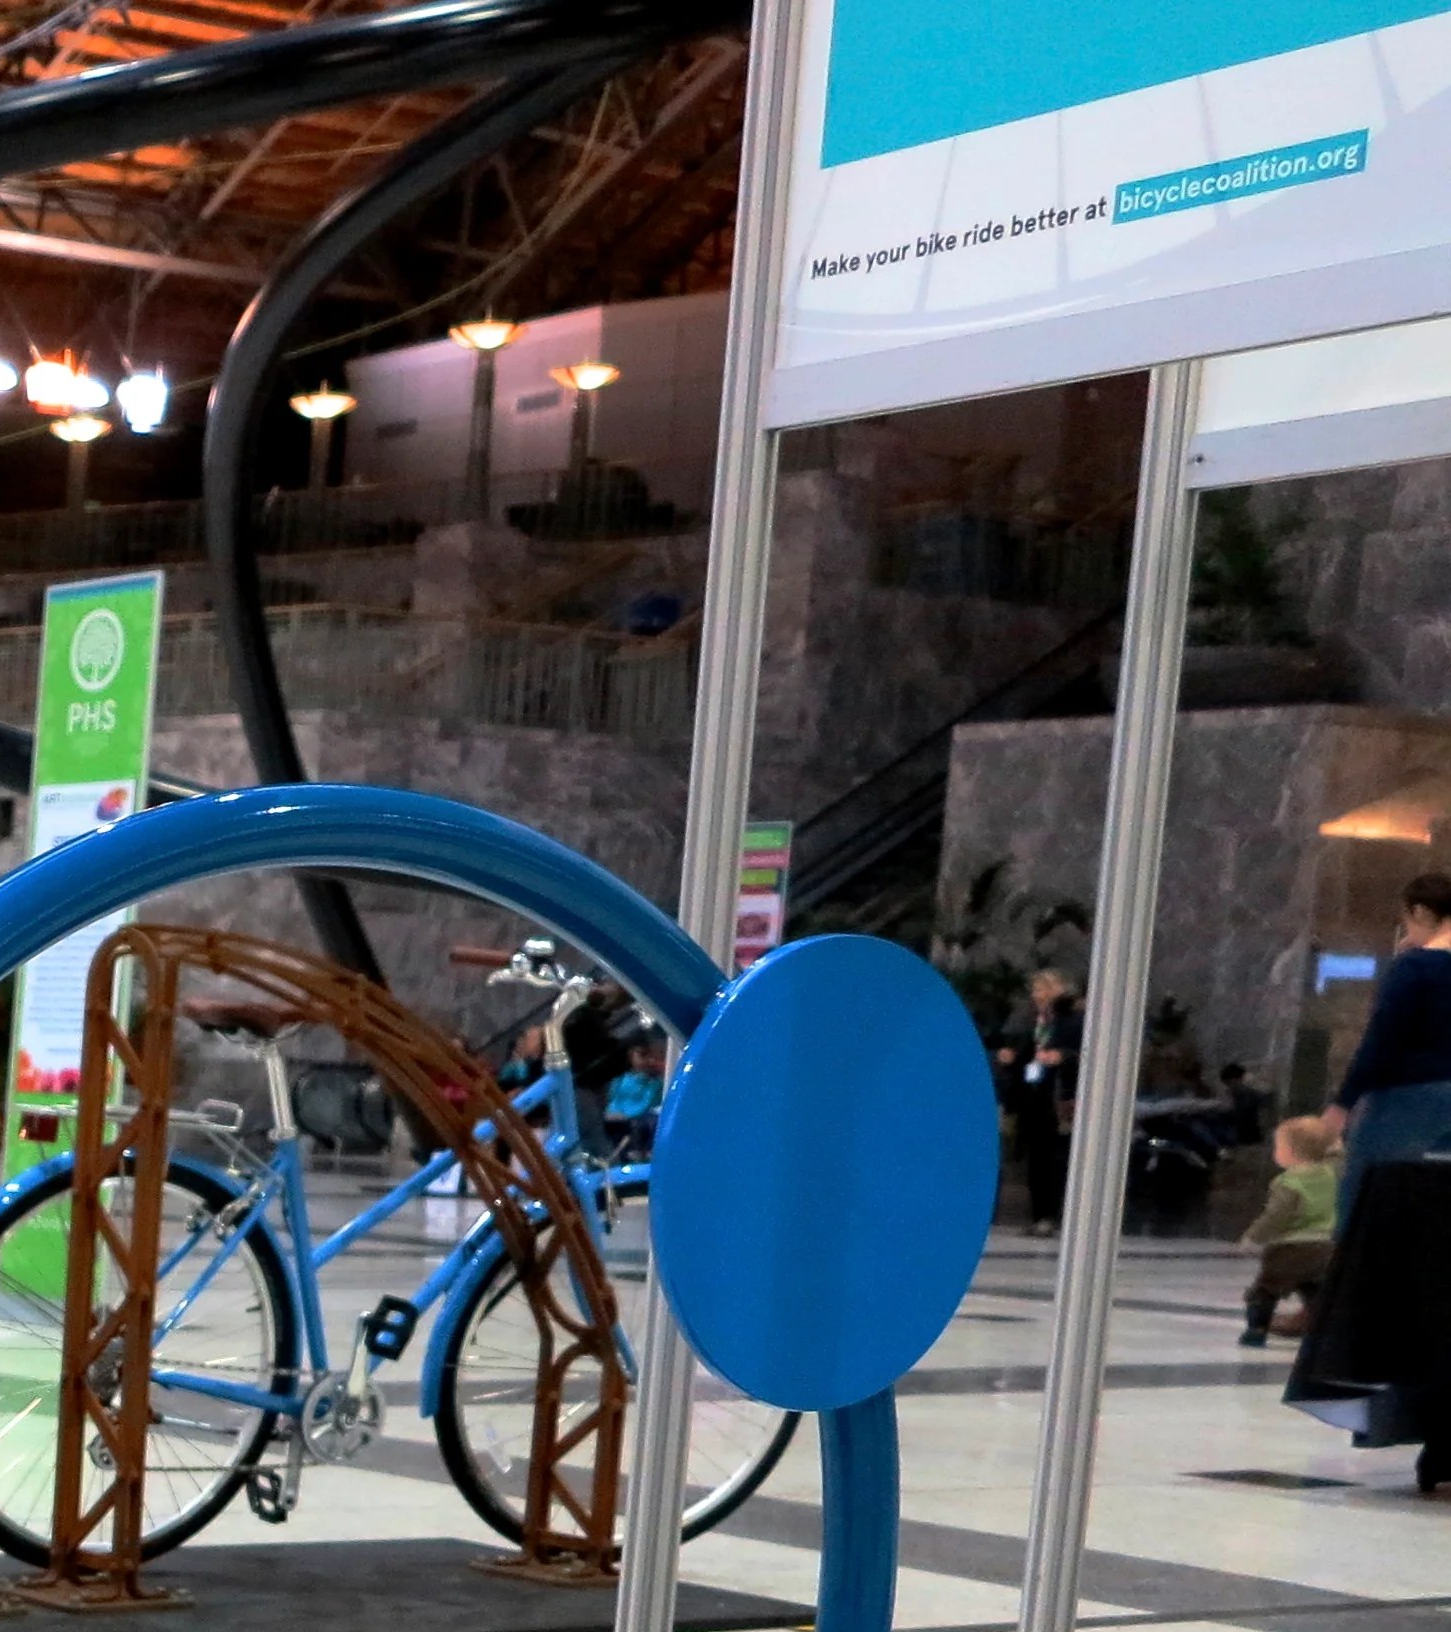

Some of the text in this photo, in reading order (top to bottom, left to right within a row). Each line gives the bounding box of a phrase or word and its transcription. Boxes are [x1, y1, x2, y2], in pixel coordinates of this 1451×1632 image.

[810, 142, 1361, 280] Make your bike ride better at bicyclecoalition.org
[66, 698, 117, 735] PHS
